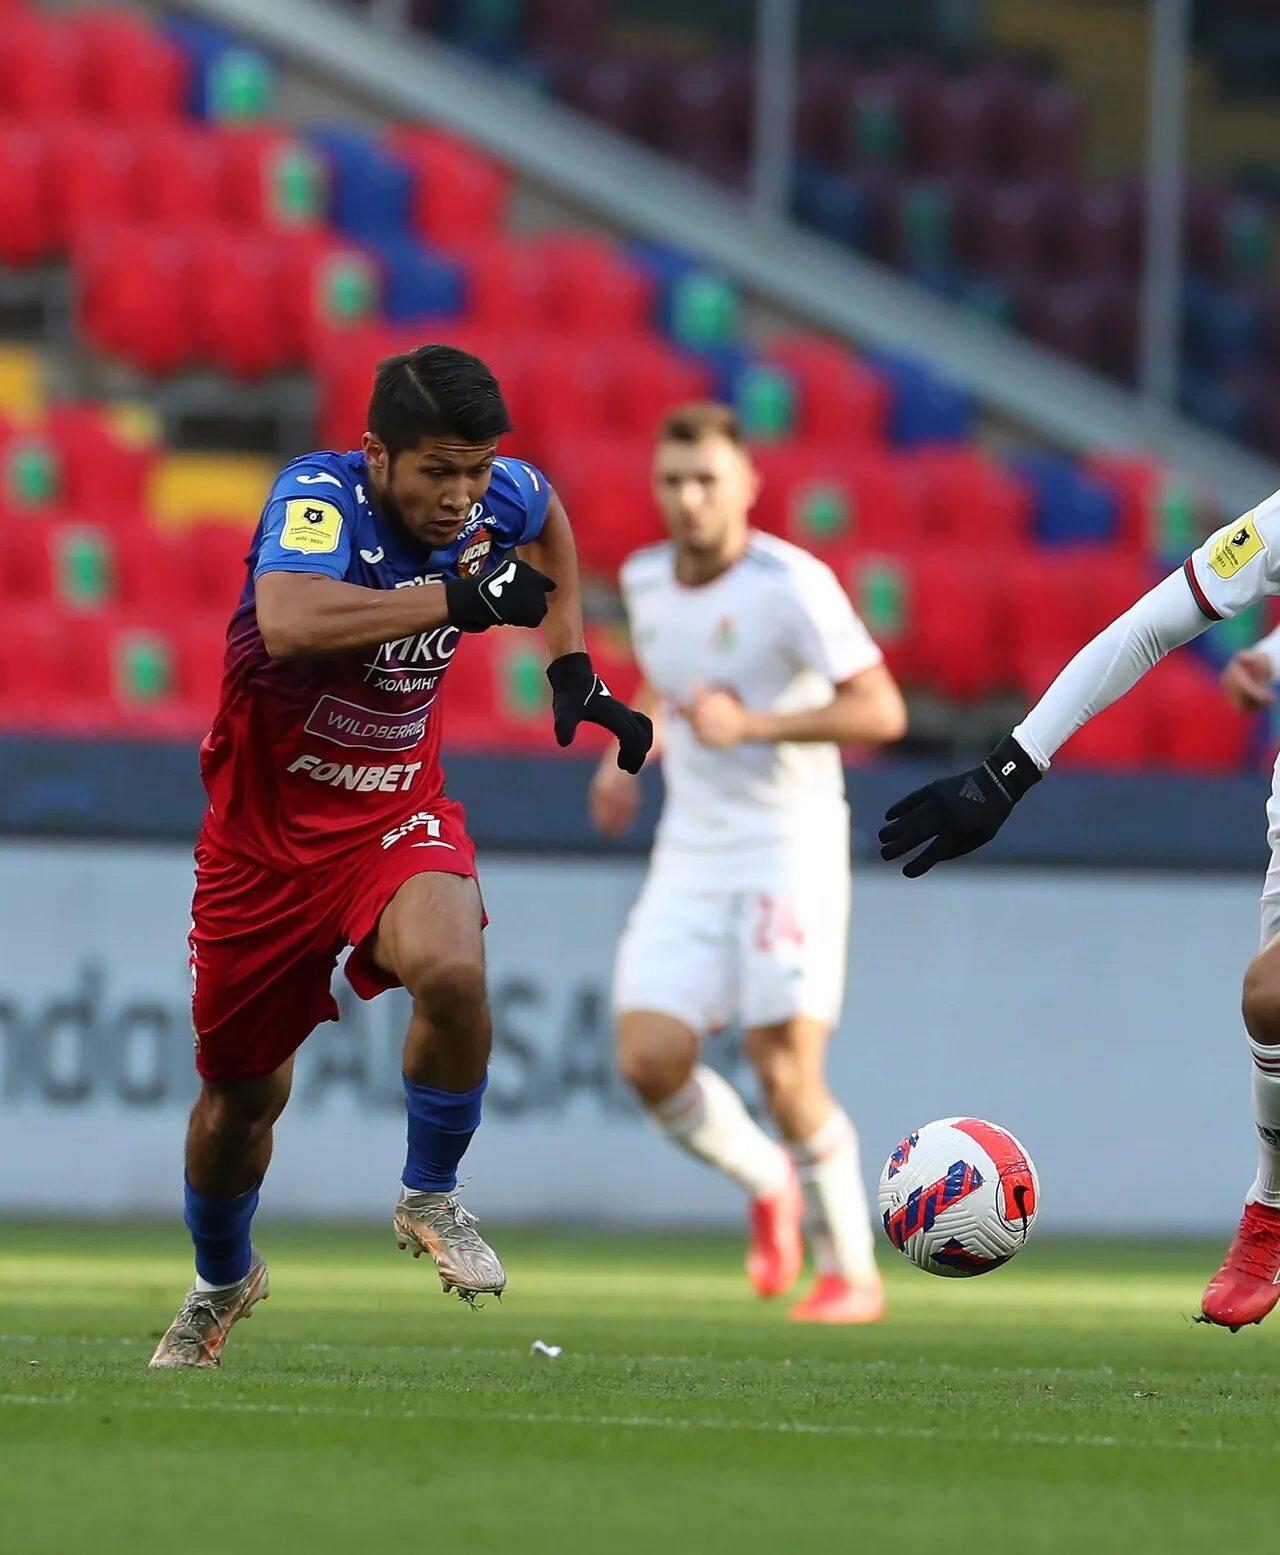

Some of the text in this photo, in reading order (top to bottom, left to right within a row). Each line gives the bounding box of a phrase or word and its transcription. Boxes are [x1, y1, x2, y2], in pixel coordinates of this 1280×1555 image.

[374, 675, 438, 693] ХОЛДИНГ
[287, 755, 421, 792] FONBET
[1001, 760, 1017, 776] 8
